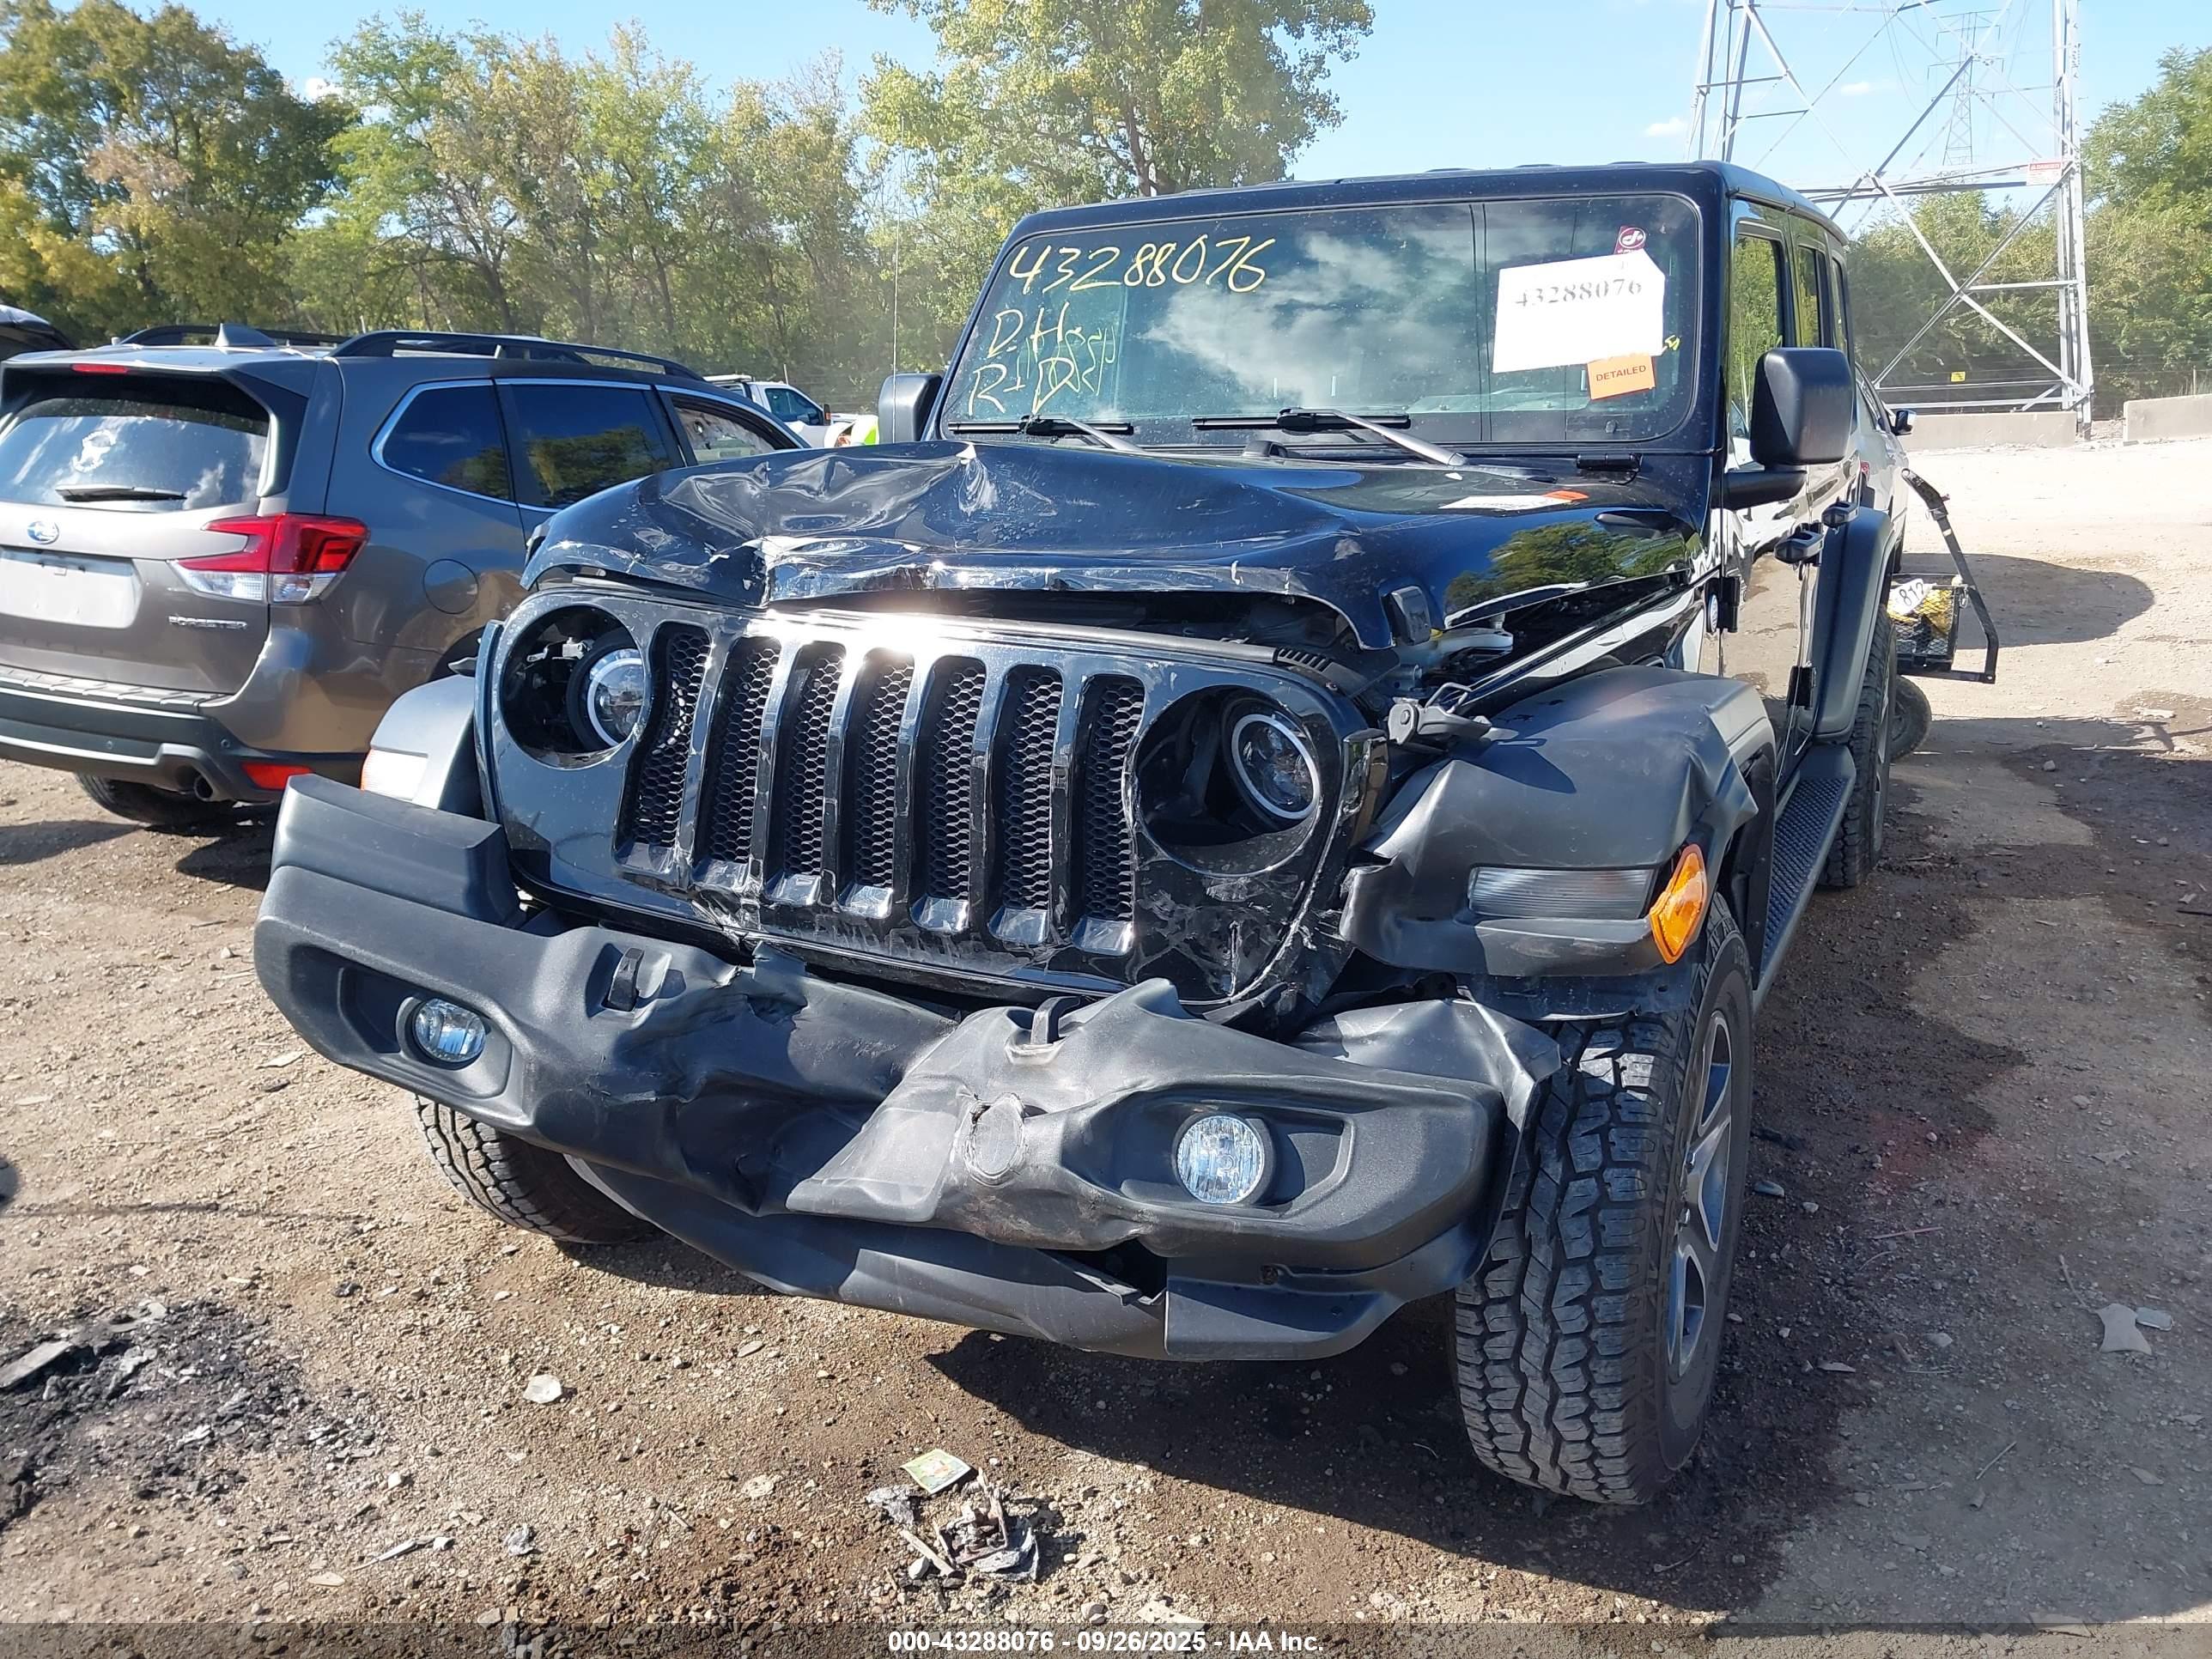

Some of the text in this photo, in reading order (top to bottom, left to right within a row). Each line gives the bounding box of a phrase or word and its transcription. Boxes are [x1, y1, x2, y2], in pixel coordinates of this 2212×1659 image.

[1009, 234, 1276, 295] 43288076
[1515, 278, 1642, 307] 43288076
[1595, 365, 1647, 381] DETAILED
